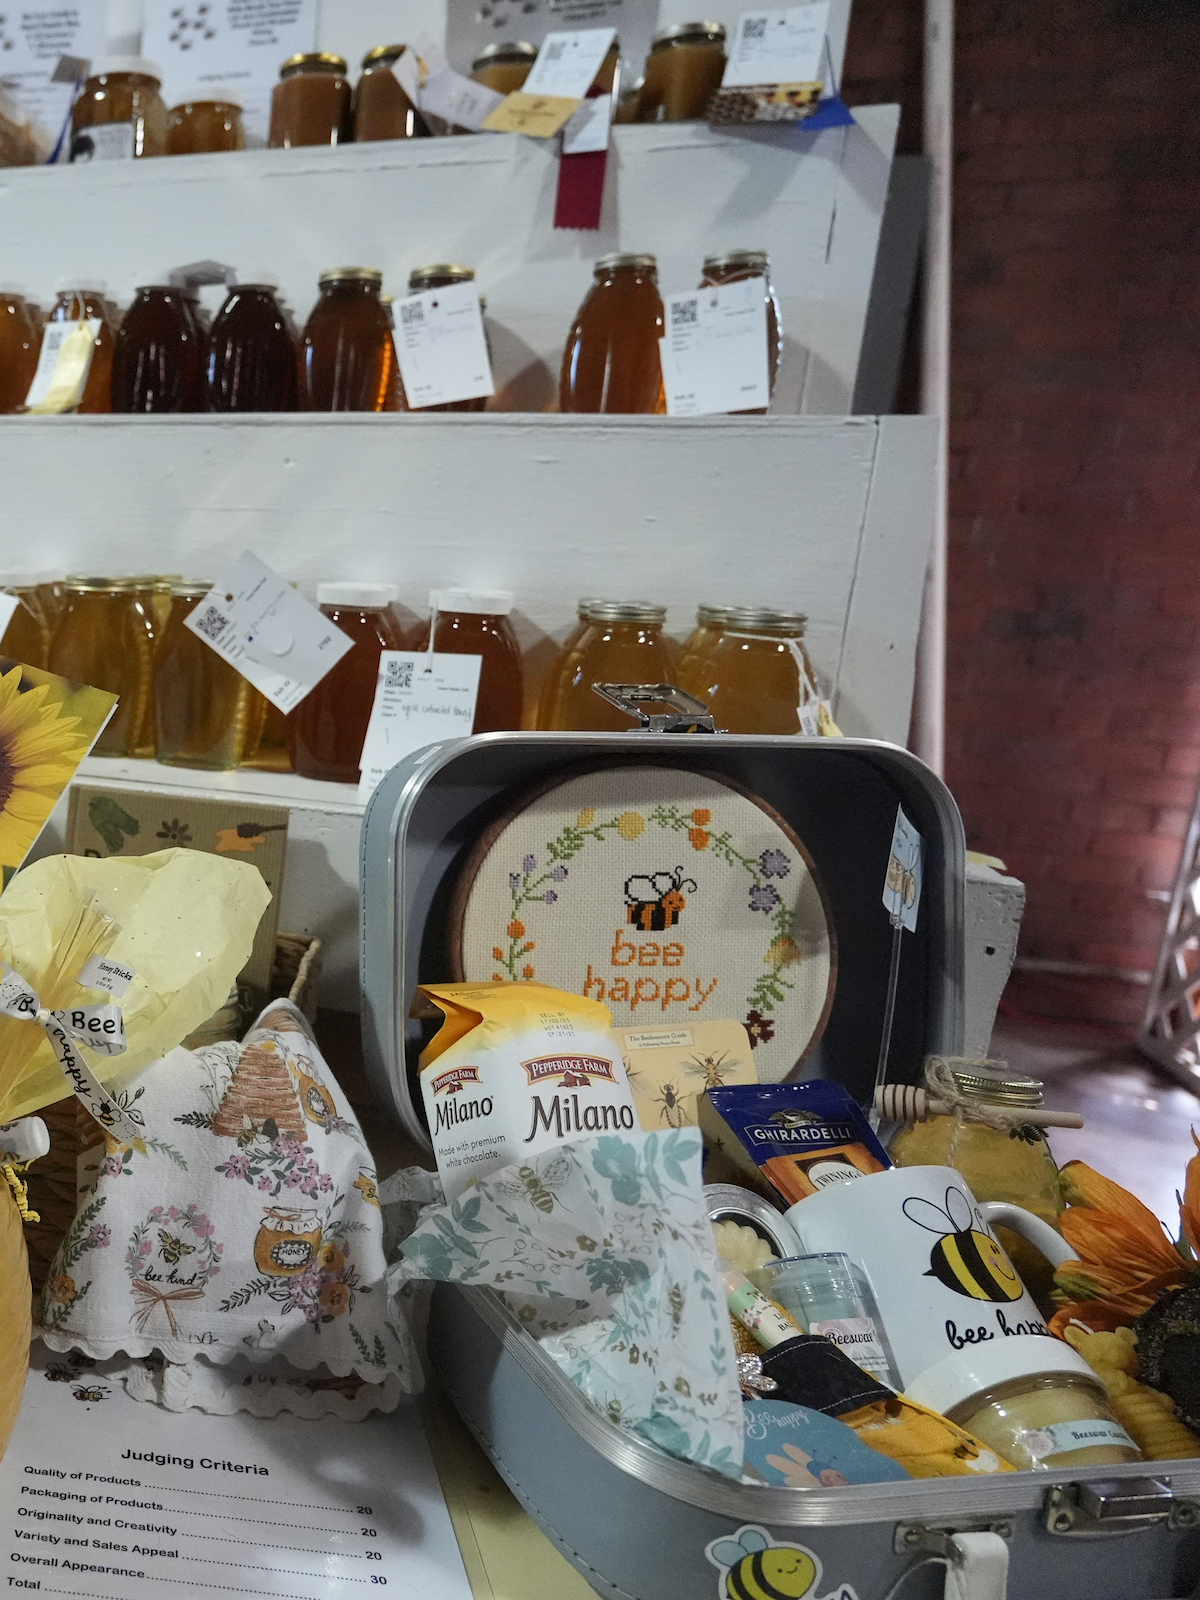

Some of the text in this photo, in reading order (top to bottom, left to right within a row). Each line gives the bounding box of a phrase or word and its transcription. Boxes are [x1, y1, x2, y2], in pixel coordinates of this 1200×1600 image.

[611, 928, 685, 966] bee
[112, 966, 134, 981] Sticks
[583, 964, 719, 1011] happy
[71, 1010, 116, 1034] Bee
[433, 1068, 476, 1092] PEPPERIDGE FARM
[531, 1057, 608, 1077] PEPPERIDGE FARM
[435, 1096, 493, 1136] Milano
[523, 1094, 634, 1144] Milano
[438, 1134, 506, 1158] Made with premium
[754, 1127, 851, 1141] GHIRARDELLI
[445, 1149, 501, 1169] white chocolate.
[281, 1248, 306, 1256] HONEY
[140, 1265, 197, 1286] bee kind
[945, 1319, 994, 1350] bee
[121, 1449, 270, 1477] Judging Criteria
[24, 1465, 373, 1515] Quality of Products 20
[20, 1485, 377, 1538] Packaging of Products 20
[17, 1506, 382, 1561] Originality and Creativity 20
[10, 1551, 146, 1579] Overall Appearance
[14, 1529, 387, 1585] Variety and Sales Appeal 30
[7, 1576, 41, 1591] Total
